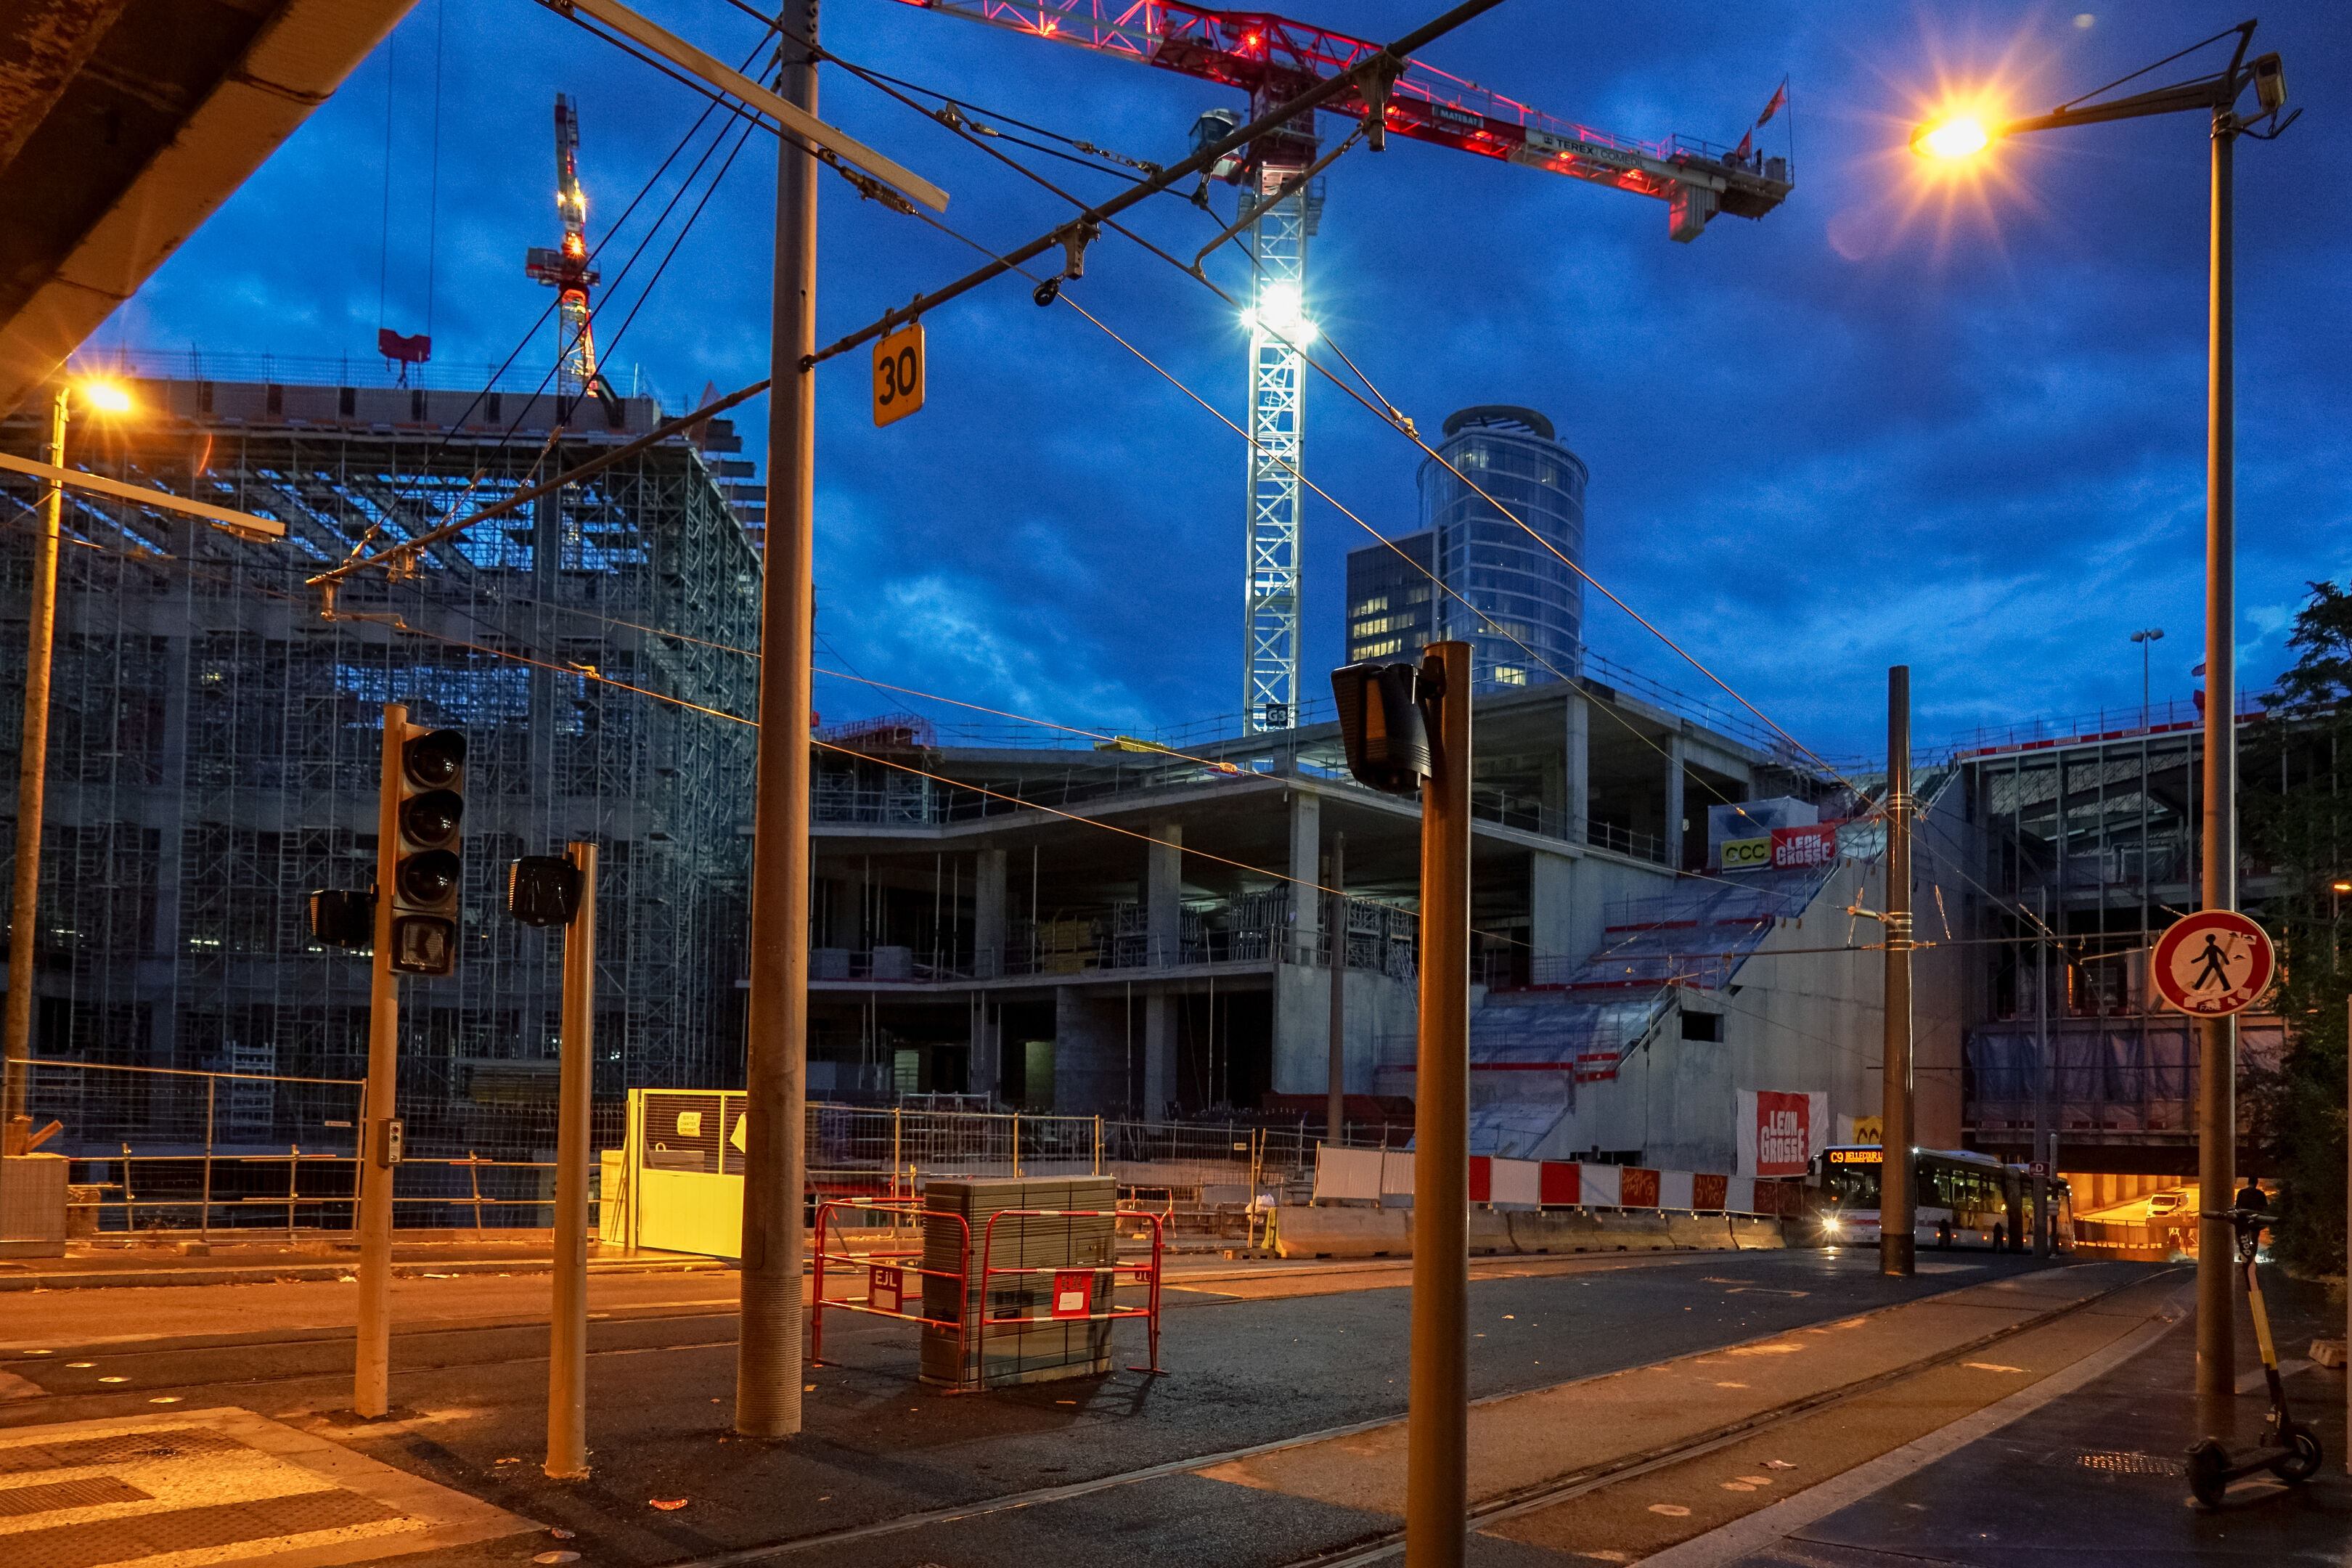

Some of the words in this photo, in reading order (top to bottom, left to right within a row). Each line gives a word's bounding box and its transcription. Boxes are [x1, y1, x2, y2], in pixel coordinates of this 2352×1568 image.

[1440, 110, 1477, 126] MATEBAT
[1556, 139, 1593, 155] TEREX
[1601, 150, 1644, 168] COMEDIL
[879, 346, 917, 405] 30
[1267, 709, 1286, 722] G3
[1787, 834, 1821, 851] LEON
[1776, 841, 1831, 866] GROSSE
[1770, 1111, 1798, 1136] LEON
[1760, 1125, 1805, 1164] GROSSE
[1830, 1151, 1844, 1163] C9
[2035, 1164, 2043, 1172] D
[875, 1270, 897, 1288] EJL
[1061, 1275, 1085, 1290] EJL
